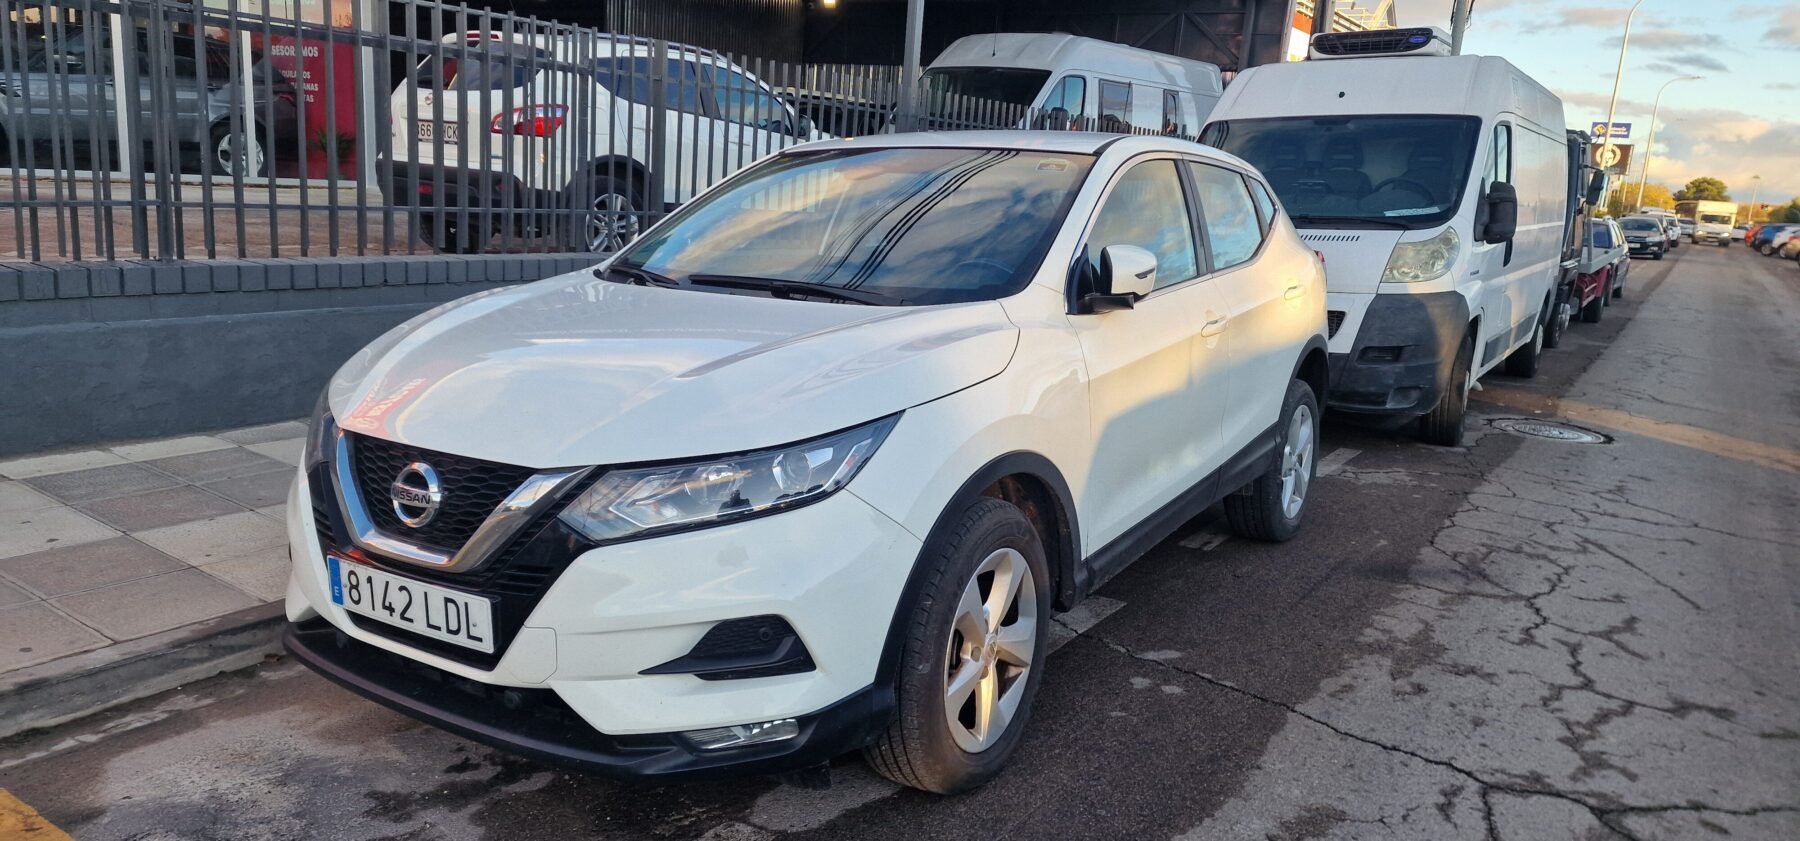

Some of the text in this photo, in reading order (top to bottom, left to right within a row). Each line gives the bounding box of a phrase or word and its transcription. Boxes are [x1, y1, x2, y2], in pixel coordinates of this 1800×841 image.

[267, 45, 319, 57] SESORMOS
[392, 486, 431, 505] NISSAN
[347, 569, 484, 643] 8142 LDL
